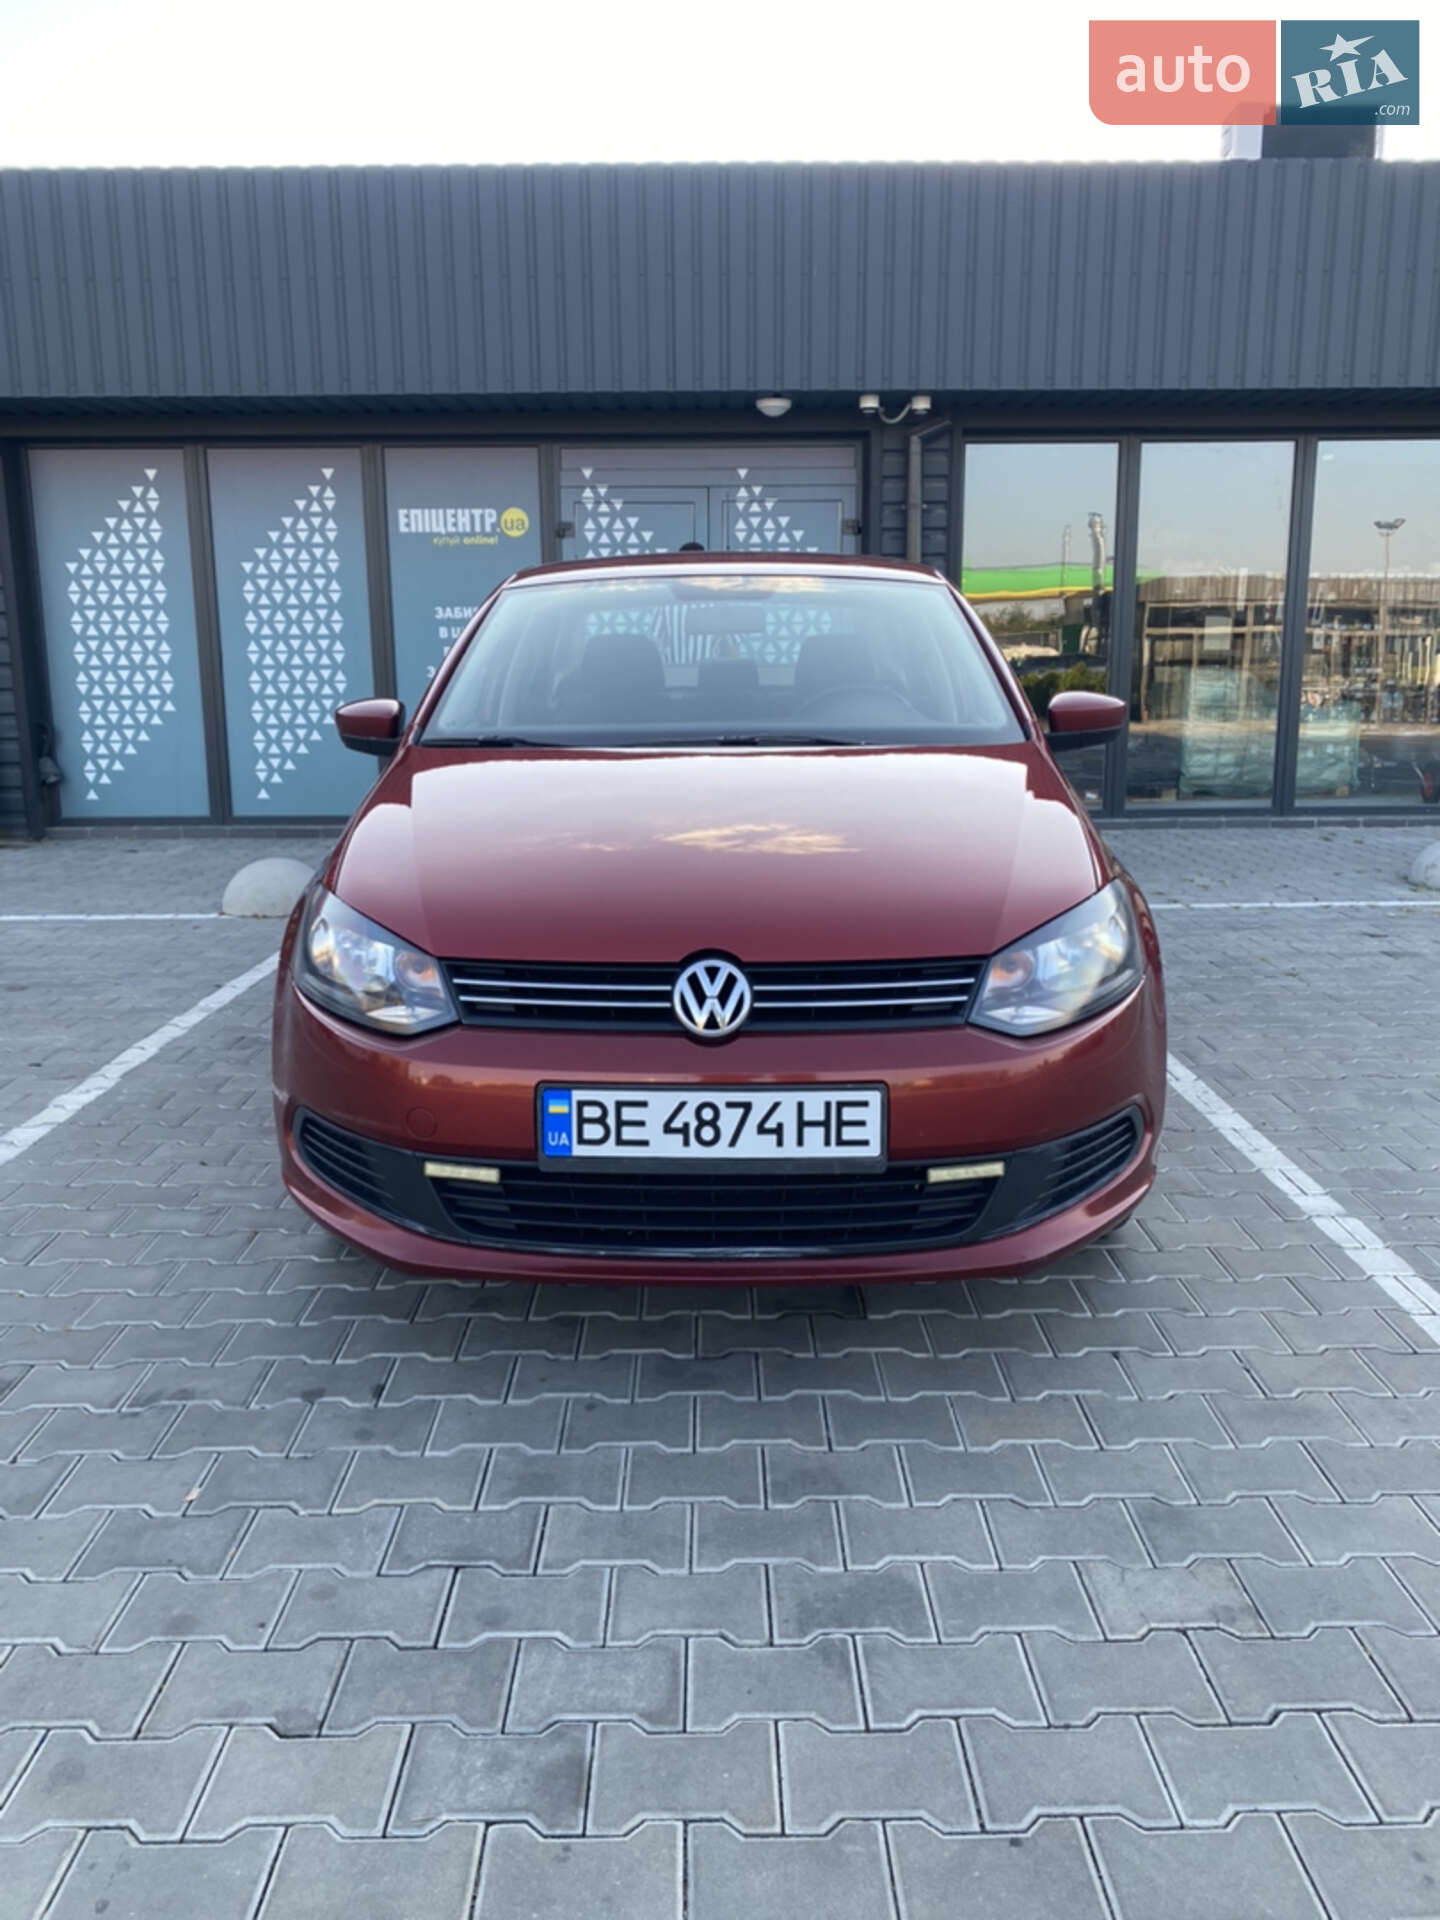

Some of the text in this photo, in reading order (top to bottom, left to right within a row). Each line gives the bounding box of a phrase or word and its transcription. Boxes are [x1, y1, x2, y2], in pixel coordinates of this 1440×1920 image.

[548, 1131, 569, 1146] UA
[576, 1099, 871, 1148] BE 4874 HE
